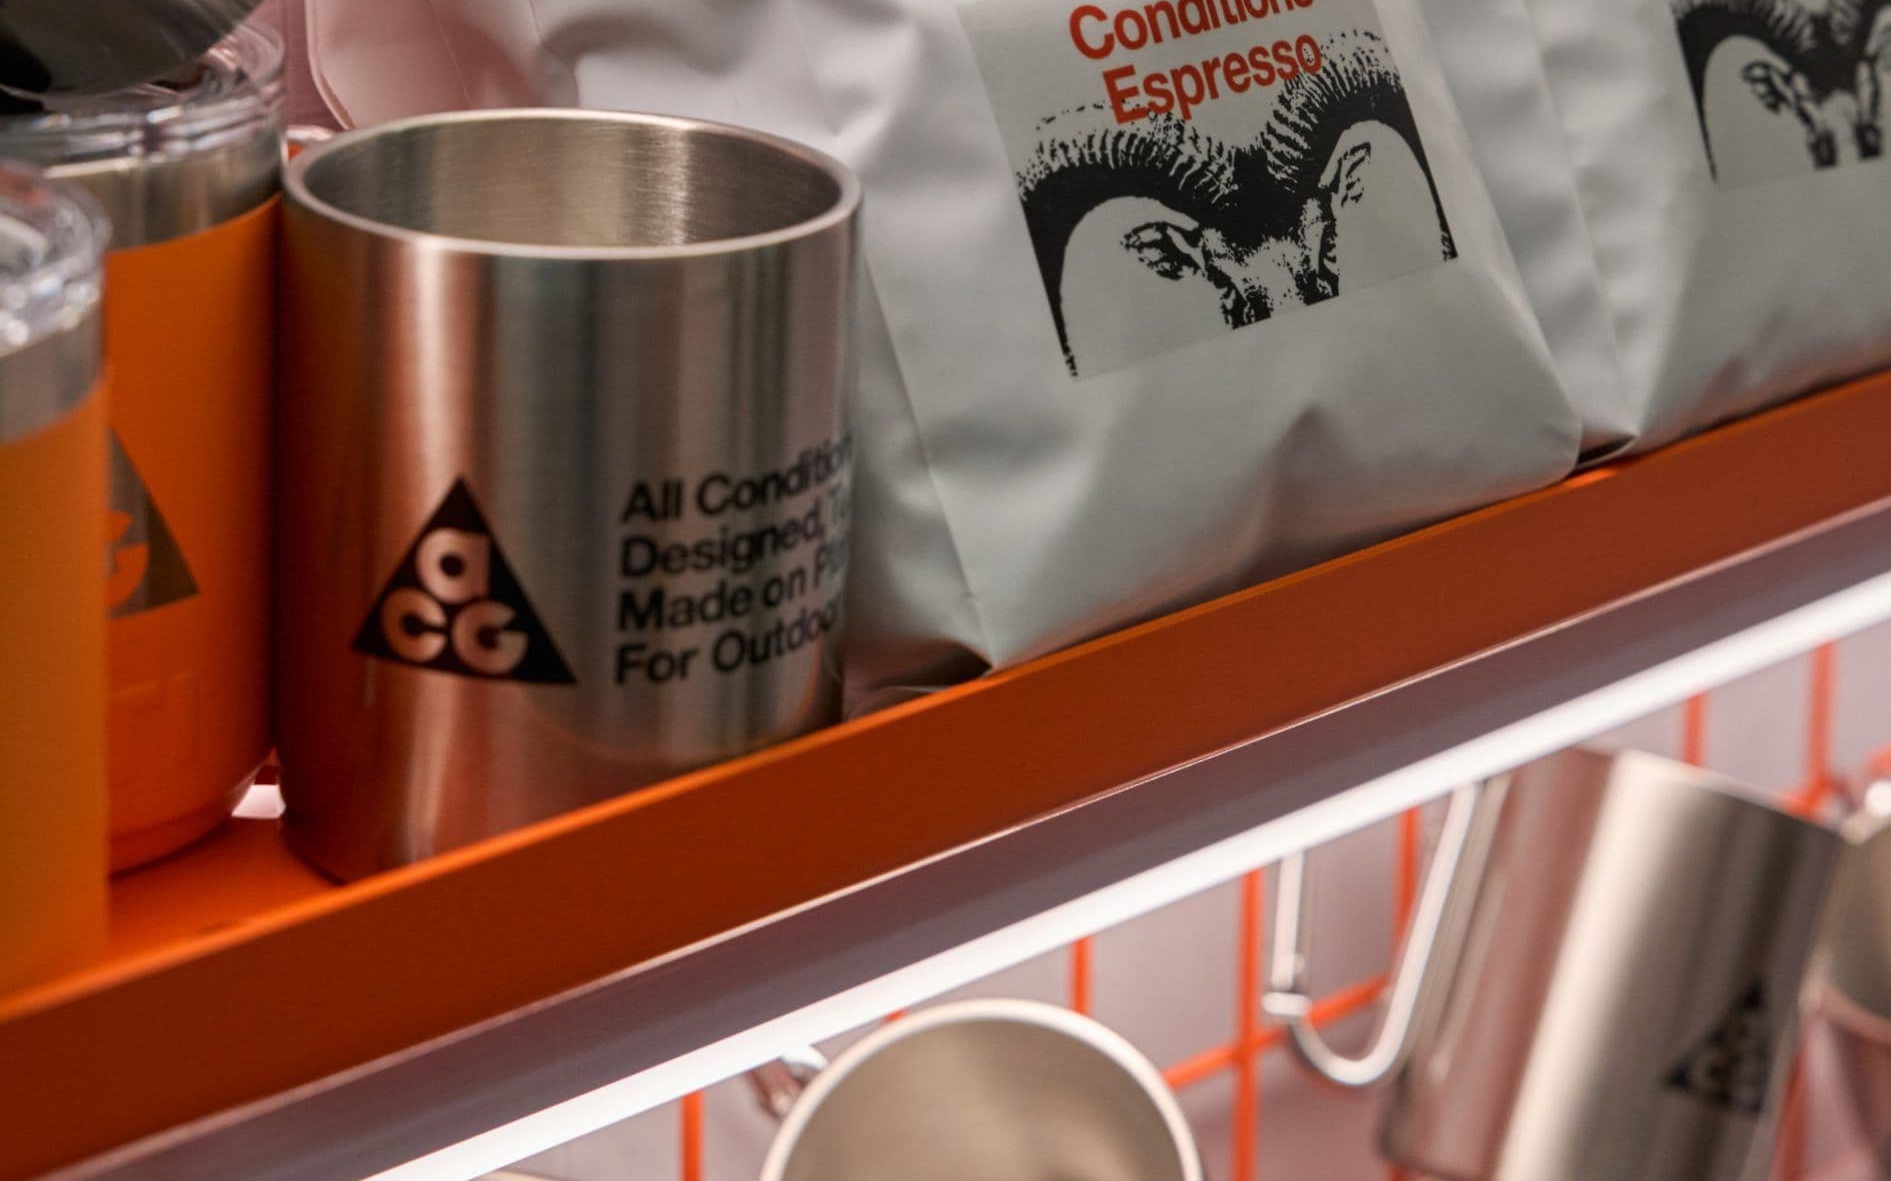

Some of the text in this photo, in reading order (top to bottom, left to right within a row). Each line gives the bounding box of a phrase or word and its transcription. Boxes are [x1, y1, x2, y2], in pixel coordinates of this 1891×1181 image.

[1102, 34, 1323, 125] Espresso
[620, 476, 684, 524] All
[618, 578, 754, 632] Made
[762, 563, 808, 608] on
[614, 644, 700, 686] For
